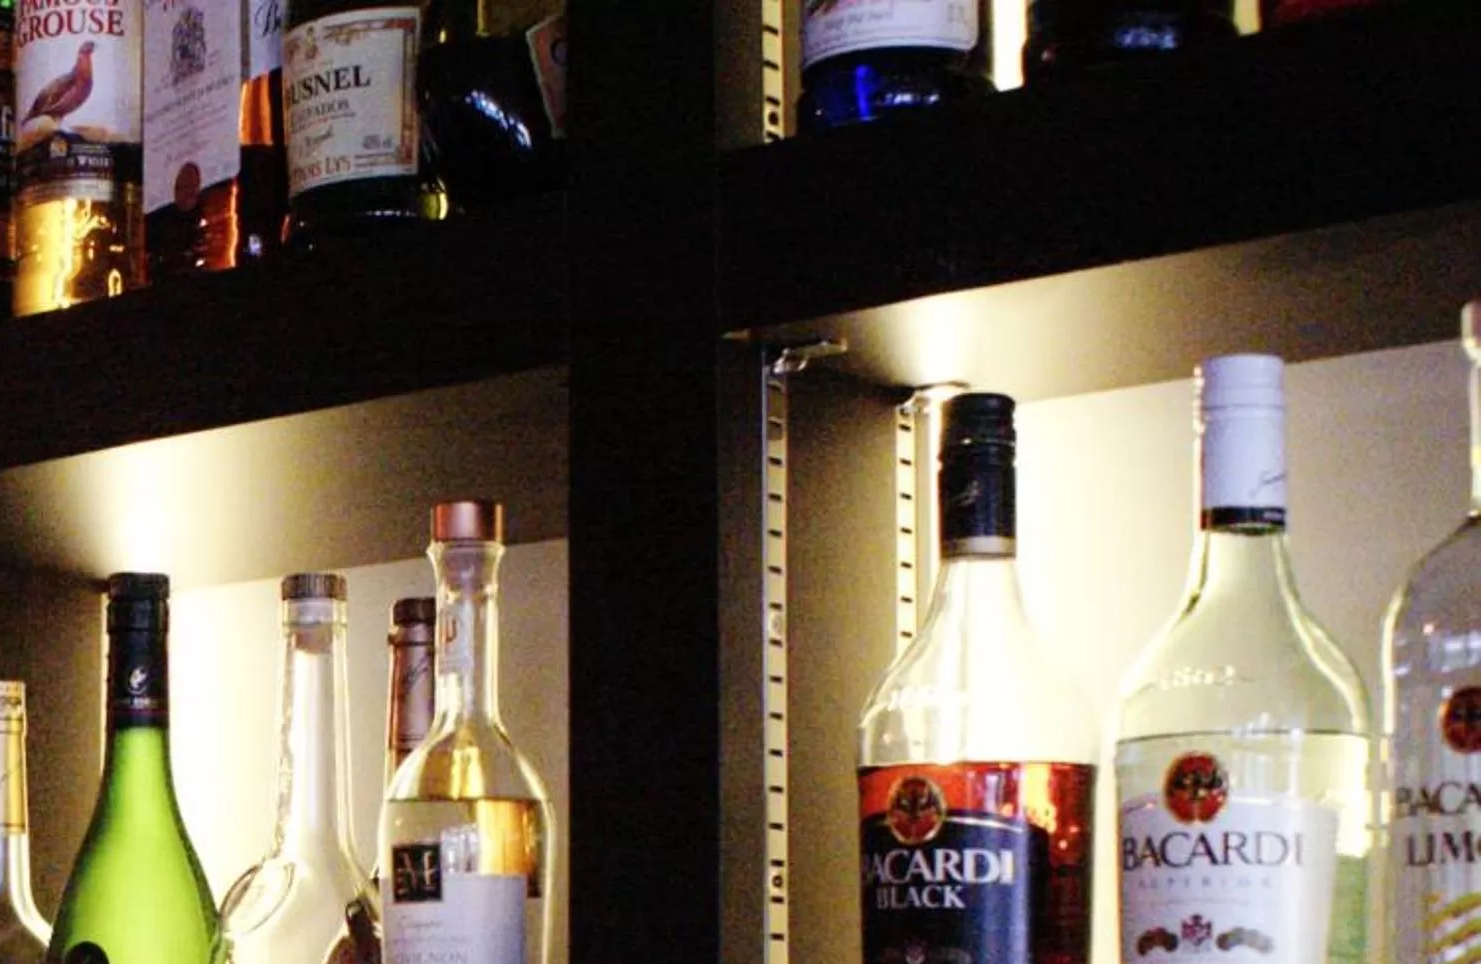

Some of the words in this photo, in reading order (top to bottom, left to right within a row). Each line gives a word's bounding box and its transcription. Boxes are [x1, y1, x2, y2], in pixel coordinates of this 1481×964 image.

[18, 10, 124, 47] GROUSE
[868, 847, 1015, 885] ACARDI
[1122, 830, 1305, 873] BACARDI
[1406, 828, 1481, 867] LIM
[876, 885, 966, 910] BLACK
